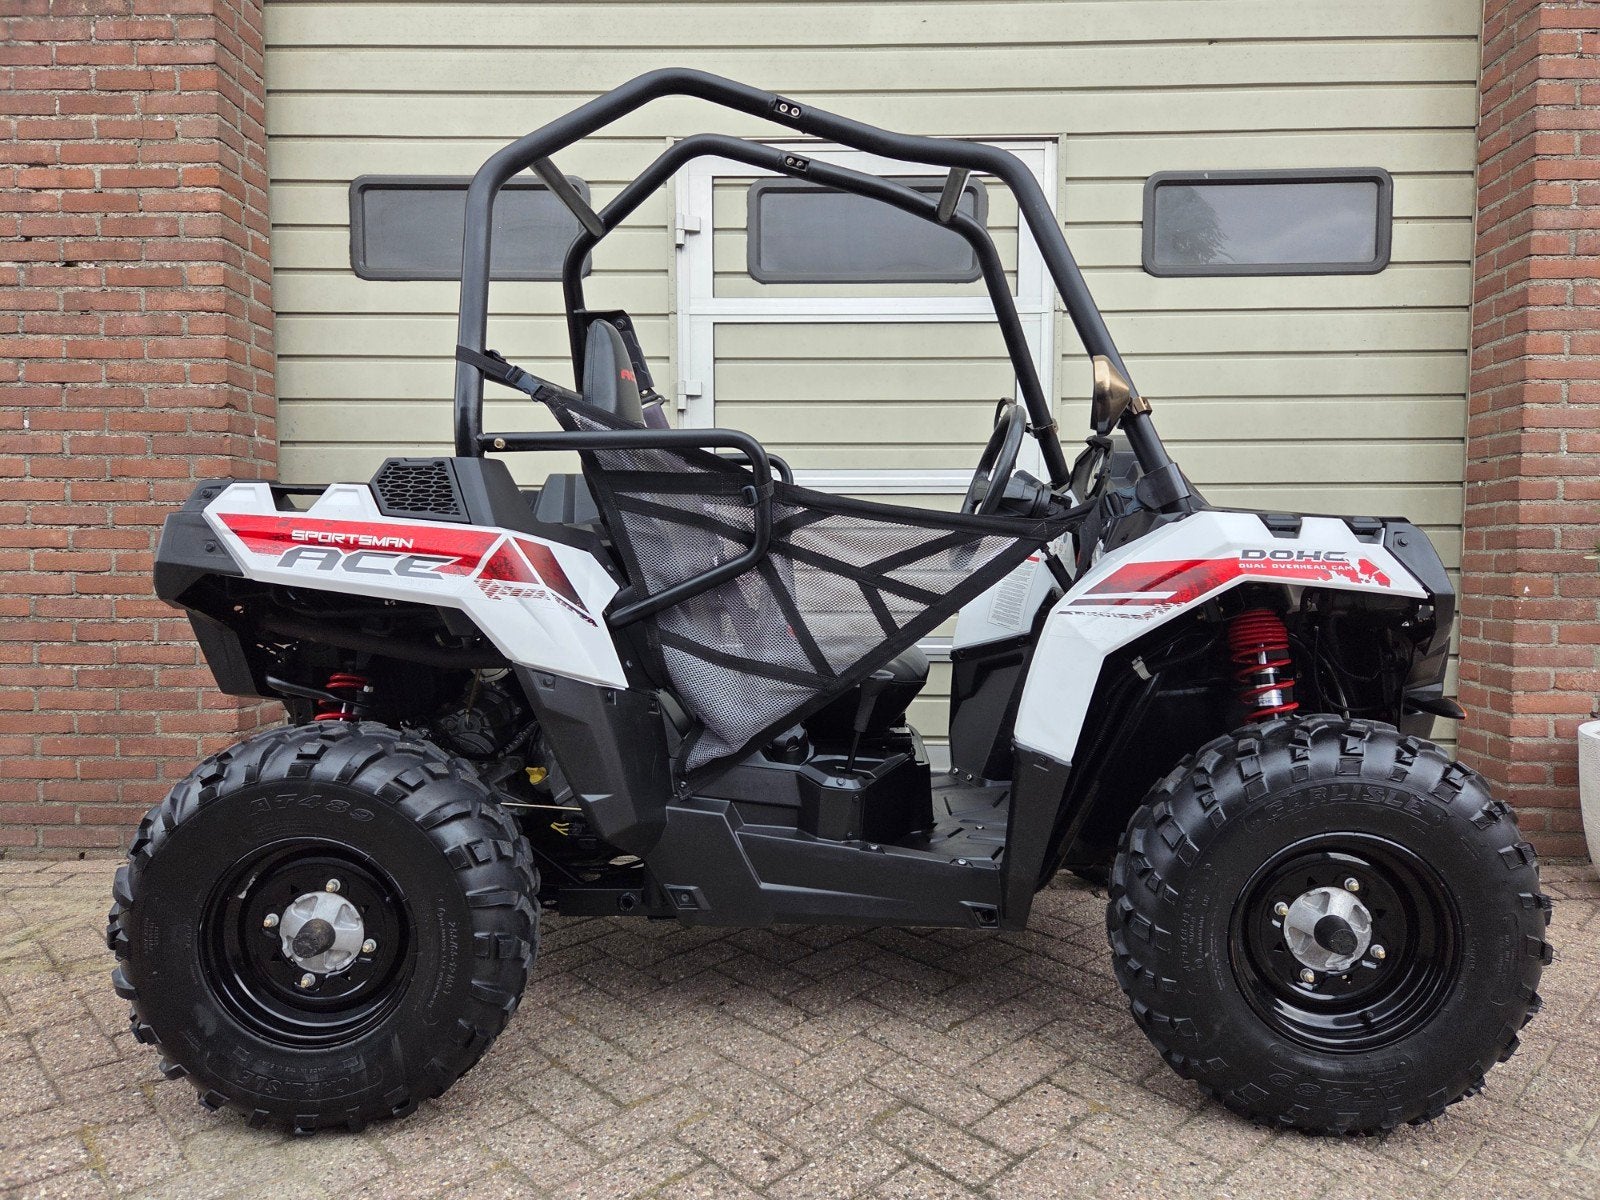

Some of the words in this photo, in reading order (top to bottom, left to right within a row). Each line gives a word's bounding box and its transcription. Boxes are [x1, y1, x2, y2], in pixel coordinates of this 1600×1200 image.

[291, 529, 414, 549] SPORTSMAN
[276, 546, 458, 580] ACE
[1241, 550, 1348, 562] DOHC
[247, 793, 376, 822] AT489
[1267, 1073, 1407, 1103] AT489
